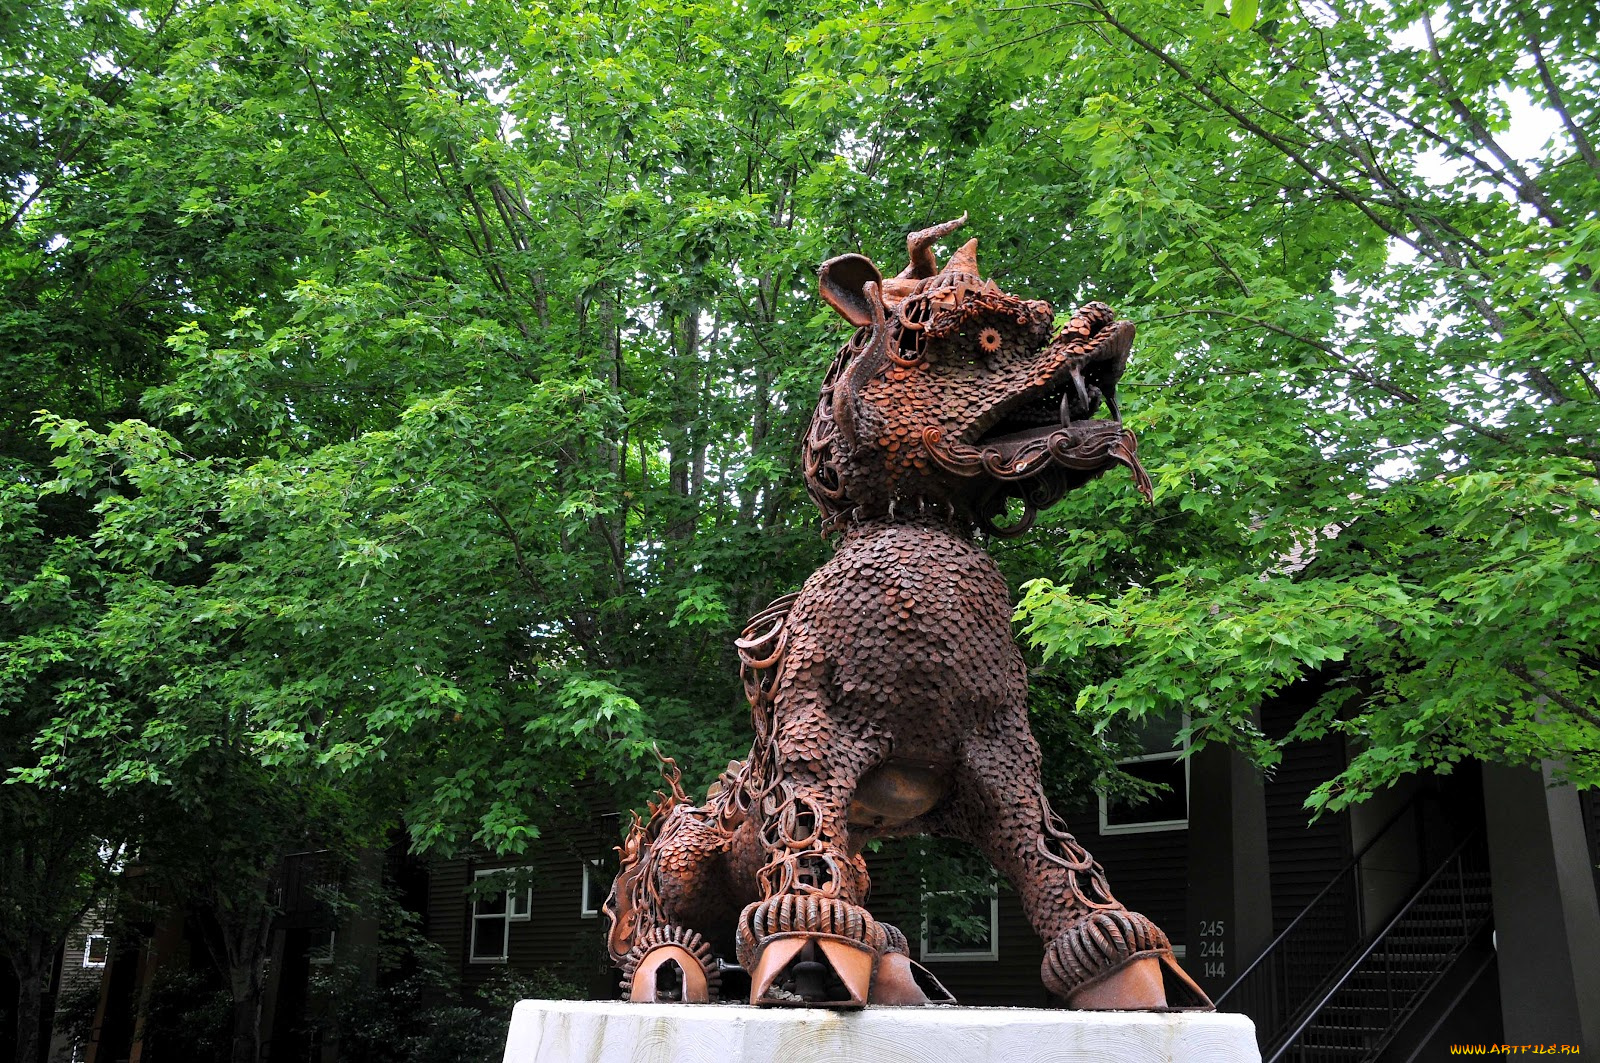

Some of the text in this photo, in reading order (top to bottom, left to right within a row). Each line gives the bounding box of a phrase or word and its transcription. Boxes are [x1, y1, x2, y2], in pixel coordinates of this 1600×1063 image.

[1200, 920, 1224, 936] 245
[1200, 941, 1225, 957] 244
[1204, 962, 1226, 978] 144
